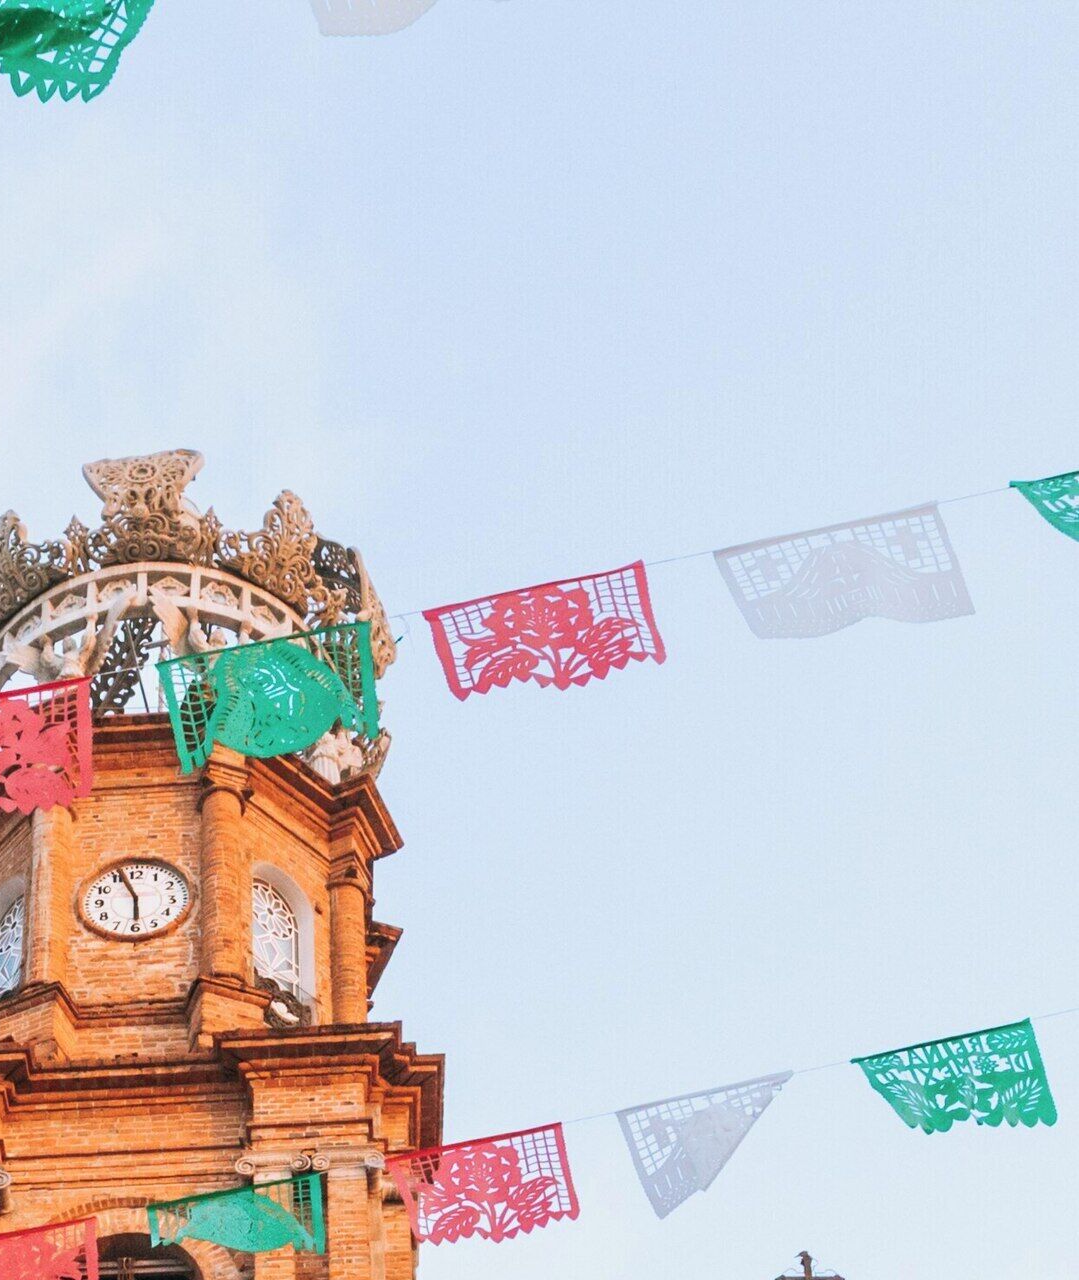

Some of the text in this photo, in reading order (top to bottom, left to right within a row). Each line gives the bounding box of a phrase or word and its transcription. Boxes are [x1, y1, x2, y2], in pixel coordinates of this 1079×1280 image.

[130, 870, 143, 879] 12
[153, 873, 158, 881] 1
[97, 886, 111, 894] 10
[165, 881, 174, 890] 2
[95, 899, 104, 908] 9
[169, 895, 176, 904] 3
[100, 912, 108, 920] 8
[161, 908, 170, 916] 4
[113, 921, 121, 930] 7
[130, 923, 140, 932] 6
[150, 919, 158, 928] 5
